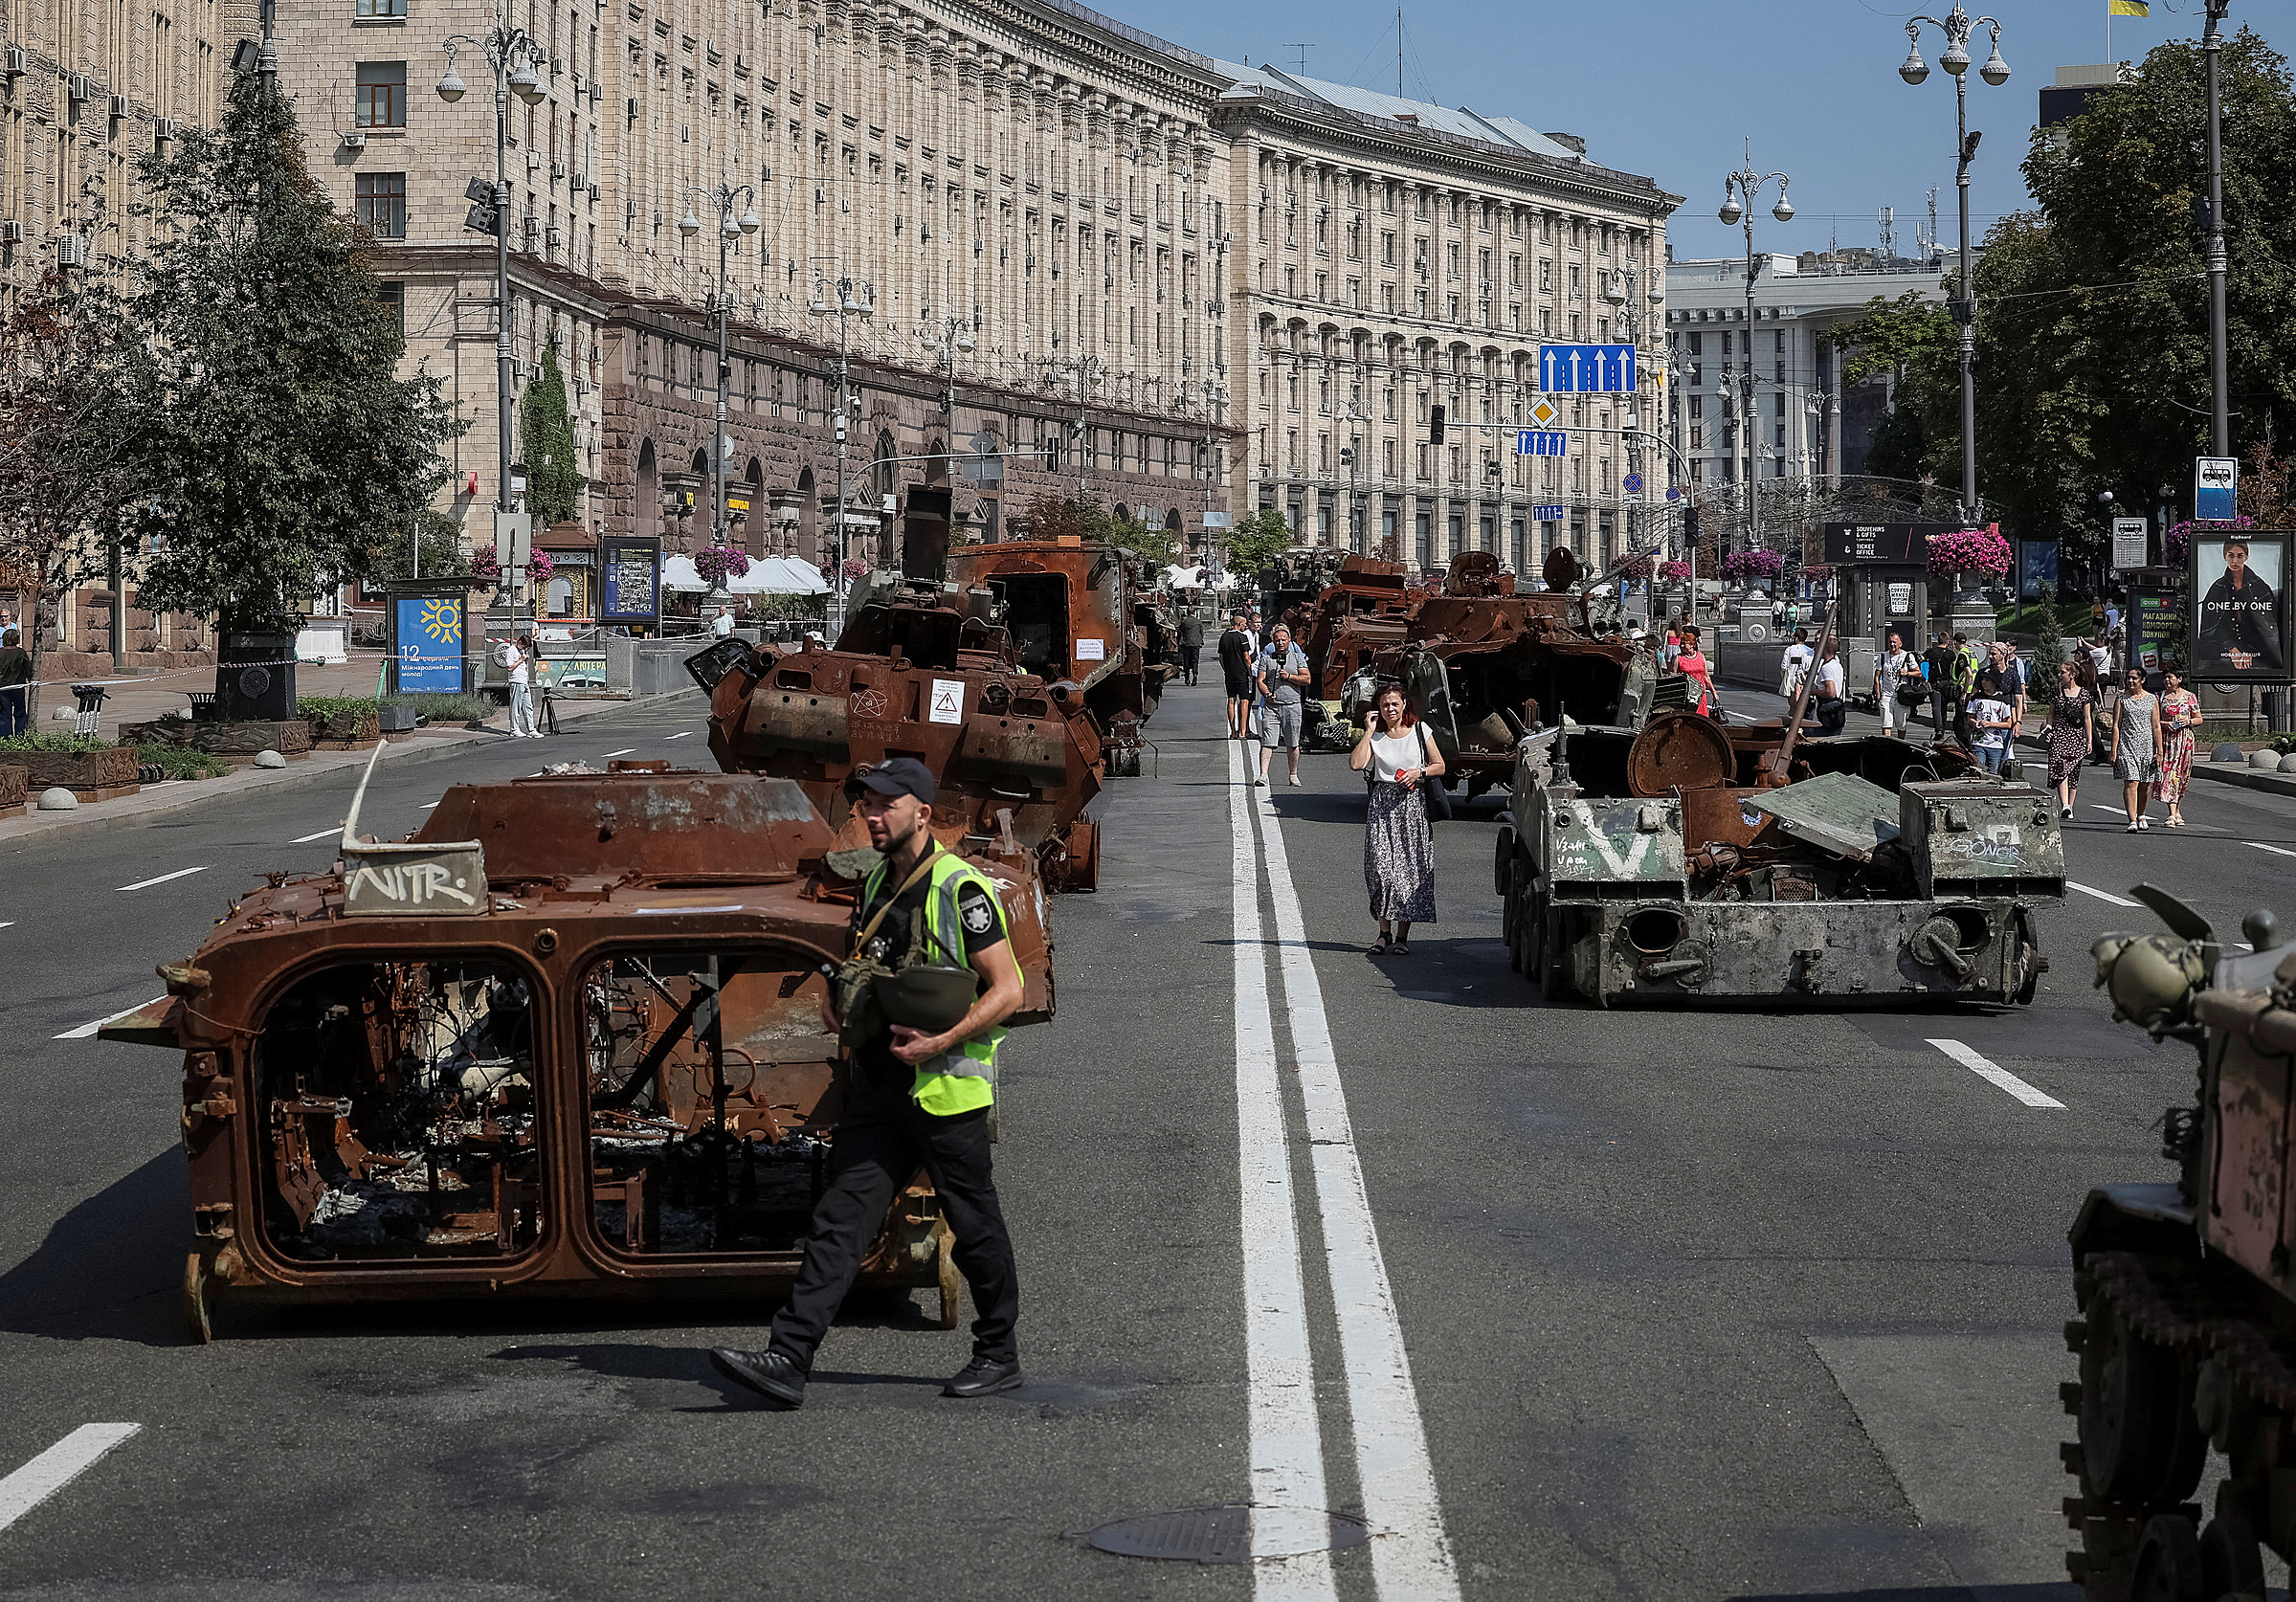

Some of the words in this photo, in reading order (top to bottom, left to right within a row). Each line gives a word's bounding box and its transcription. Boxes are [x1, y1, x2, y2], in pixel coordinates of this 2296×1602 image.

[2207, 601, 2231, 611] ONE
[2234, 602, 2247, 611] BY
[2250, 601, 2273, 611] ONE
[2142, 612, 2177, 621] МАГАЗИНИ
[401, 645, 420, 662] 12
